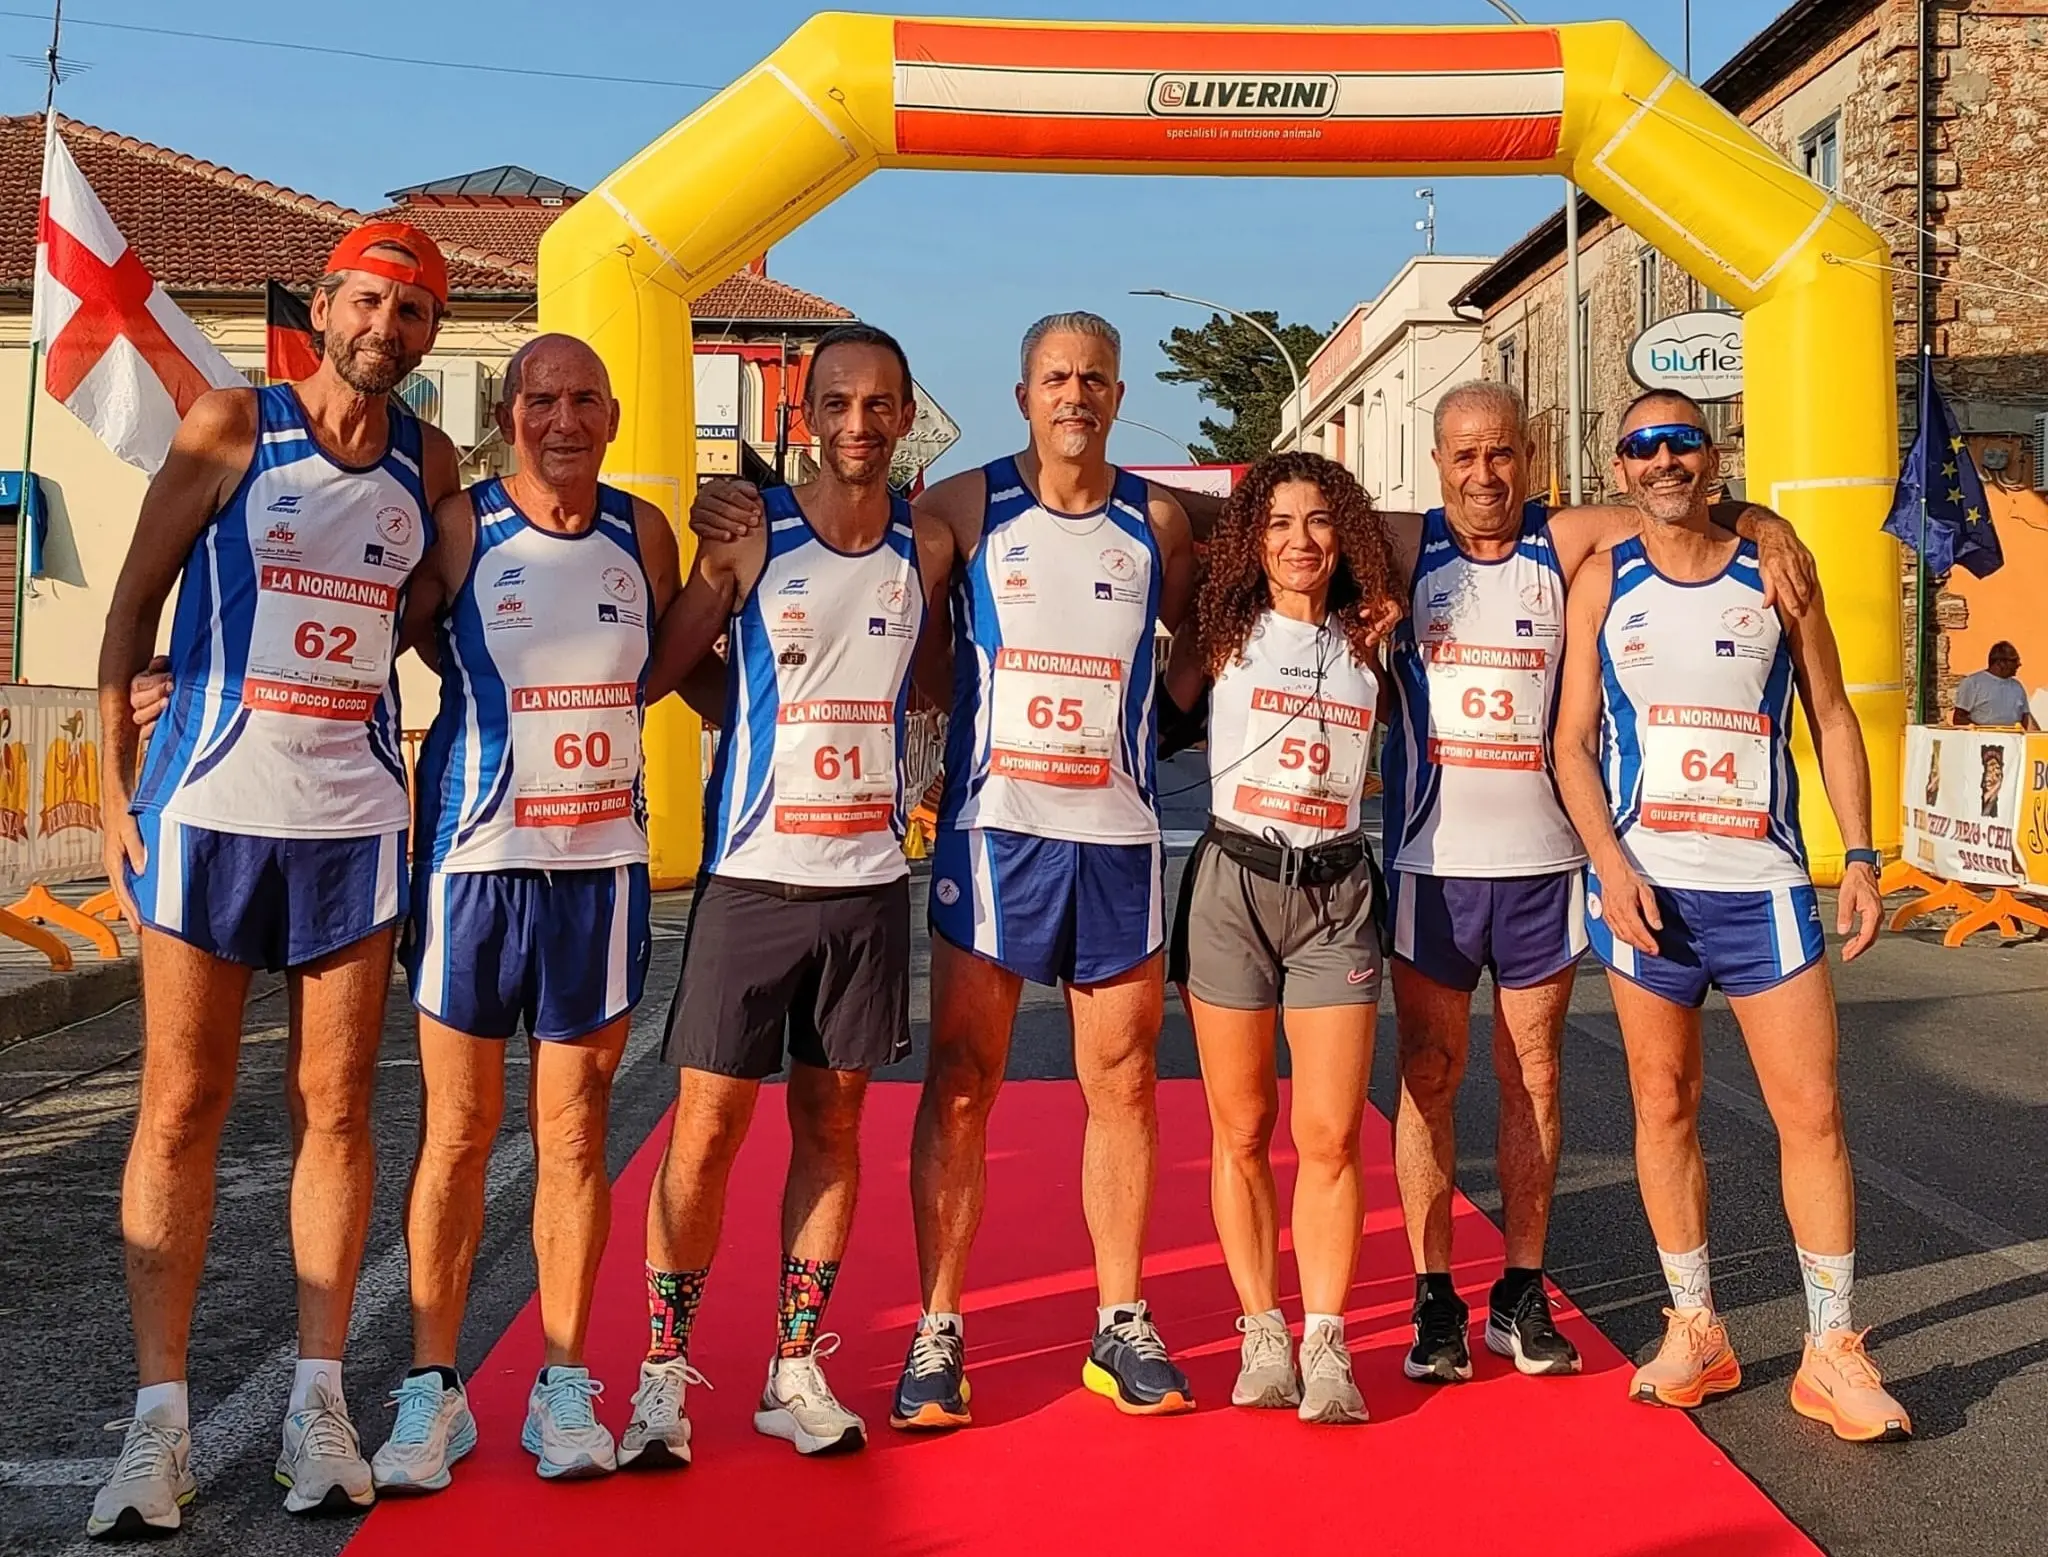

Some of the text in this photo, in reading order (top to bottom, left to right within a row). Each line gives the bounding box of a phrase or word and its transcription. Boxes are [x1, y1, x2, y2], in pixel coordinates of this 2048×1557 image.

[1184, 81, 1328, 108] LIVERINI
[1166, 127, 1322, 139] specialisti in nutrizione animale
[696, 427, 736, 438] BOLLATI
[271, 570, 388, 607] LA NORMANNA
[294, 621, 357, 664] 62
[1004, 652, 1112, 678] LA NORMANNA
[1439, 645, 1537, 668] LA NORMANNA
[1279, 666, 1328, 680] adidas
[255, 686, 367, 711] ITALO ROCCO LOCOCO
[521, 687, 631, 709] LA NORMANNA
[1260, 694, 1361, 727] LA NORMANNA
[1461, 686, 1514, 722] 63
[786, 703, 888, 722] LA NORMANNA
[1027, 695, 1083, 732] 65
[1657, 708, 1762, 733] LA NORMANNA
[554, 731, 611, 770] 60
[814, 745, 861, 781] 61
[1278, 737, 1331, 776] 59
[1475, 749, 1537, 762] MERCATANTE
[1000, 754, 1100, 776] ANTONINO PANUCCIO
[1681, 749, 1738, 785] 64
[525, 797, 627, 817] ANNUNZIATO BRIGA
[1260, 795, 1291, 811] ANNA
[1650, 808, 1761, 829] GIUSEPPE MERCATANTE
